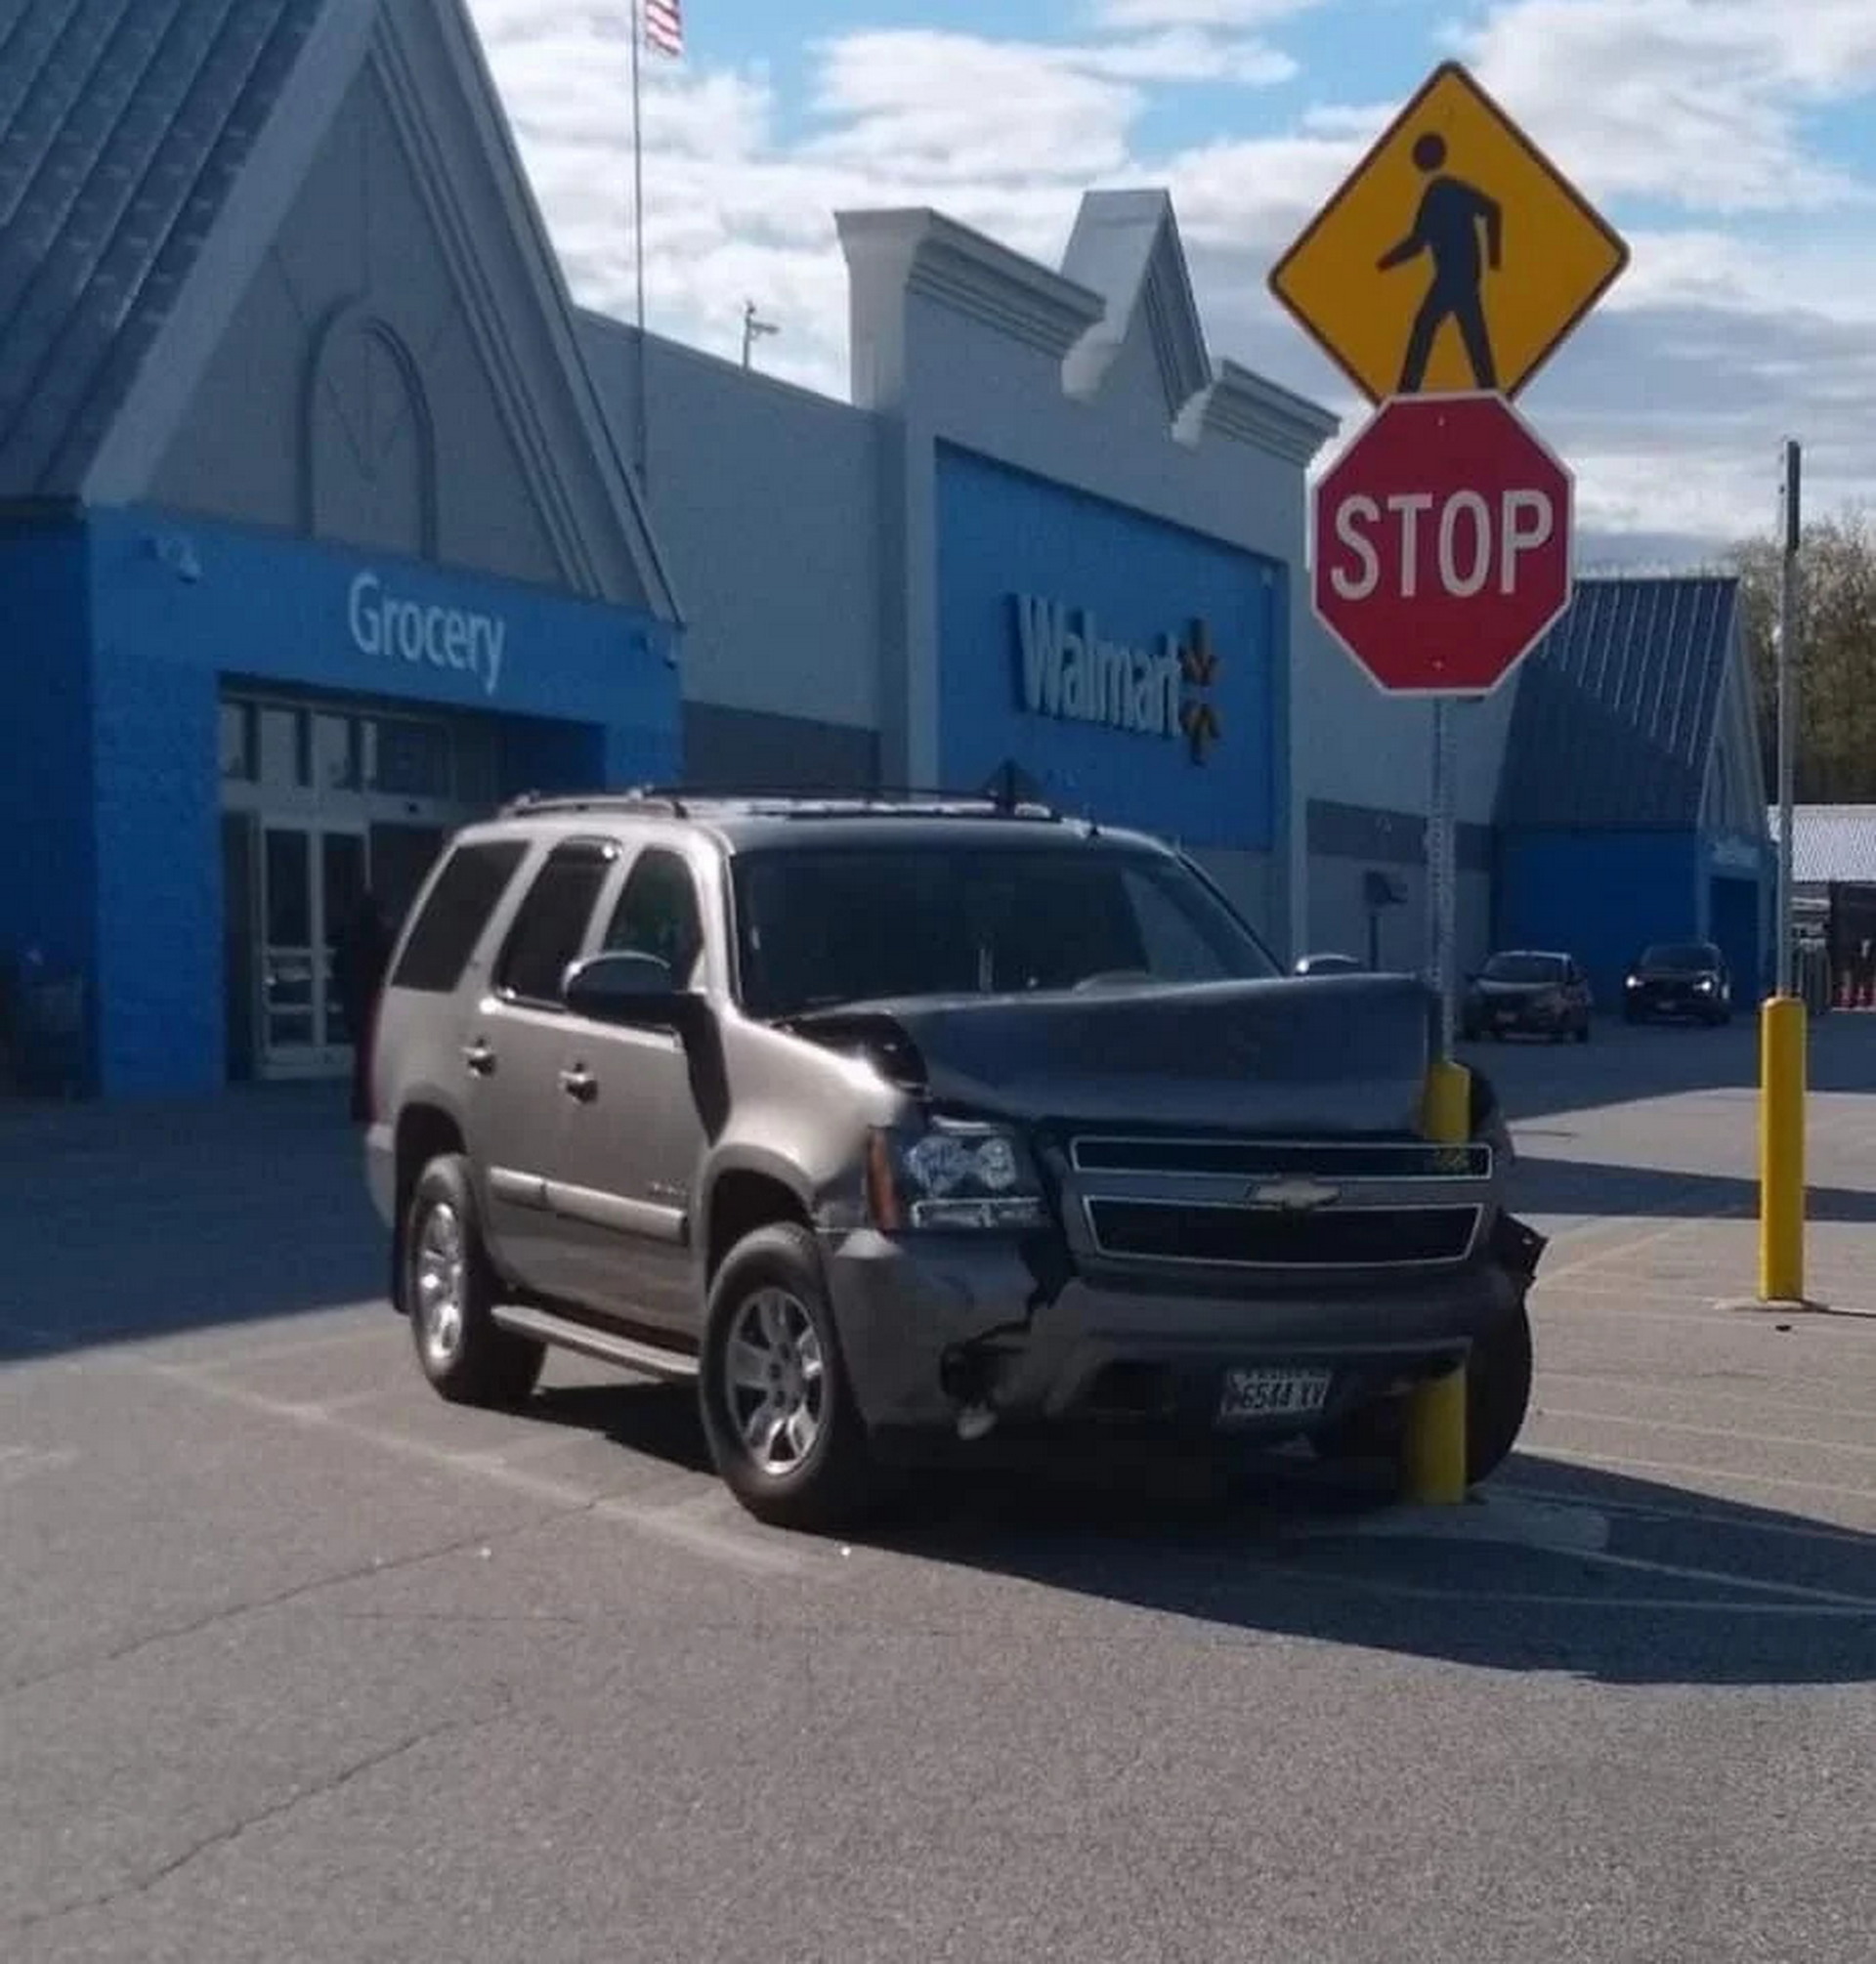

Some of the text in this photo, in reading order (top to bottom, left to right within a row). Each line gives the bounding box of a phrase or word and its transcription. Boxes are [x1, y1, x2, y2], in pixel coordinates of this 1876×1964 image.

[1331, 490, 1554, 601] STOP
[349, 572, 505, 696] Grocery
[1017, 594, 1181, 737] Walmart
